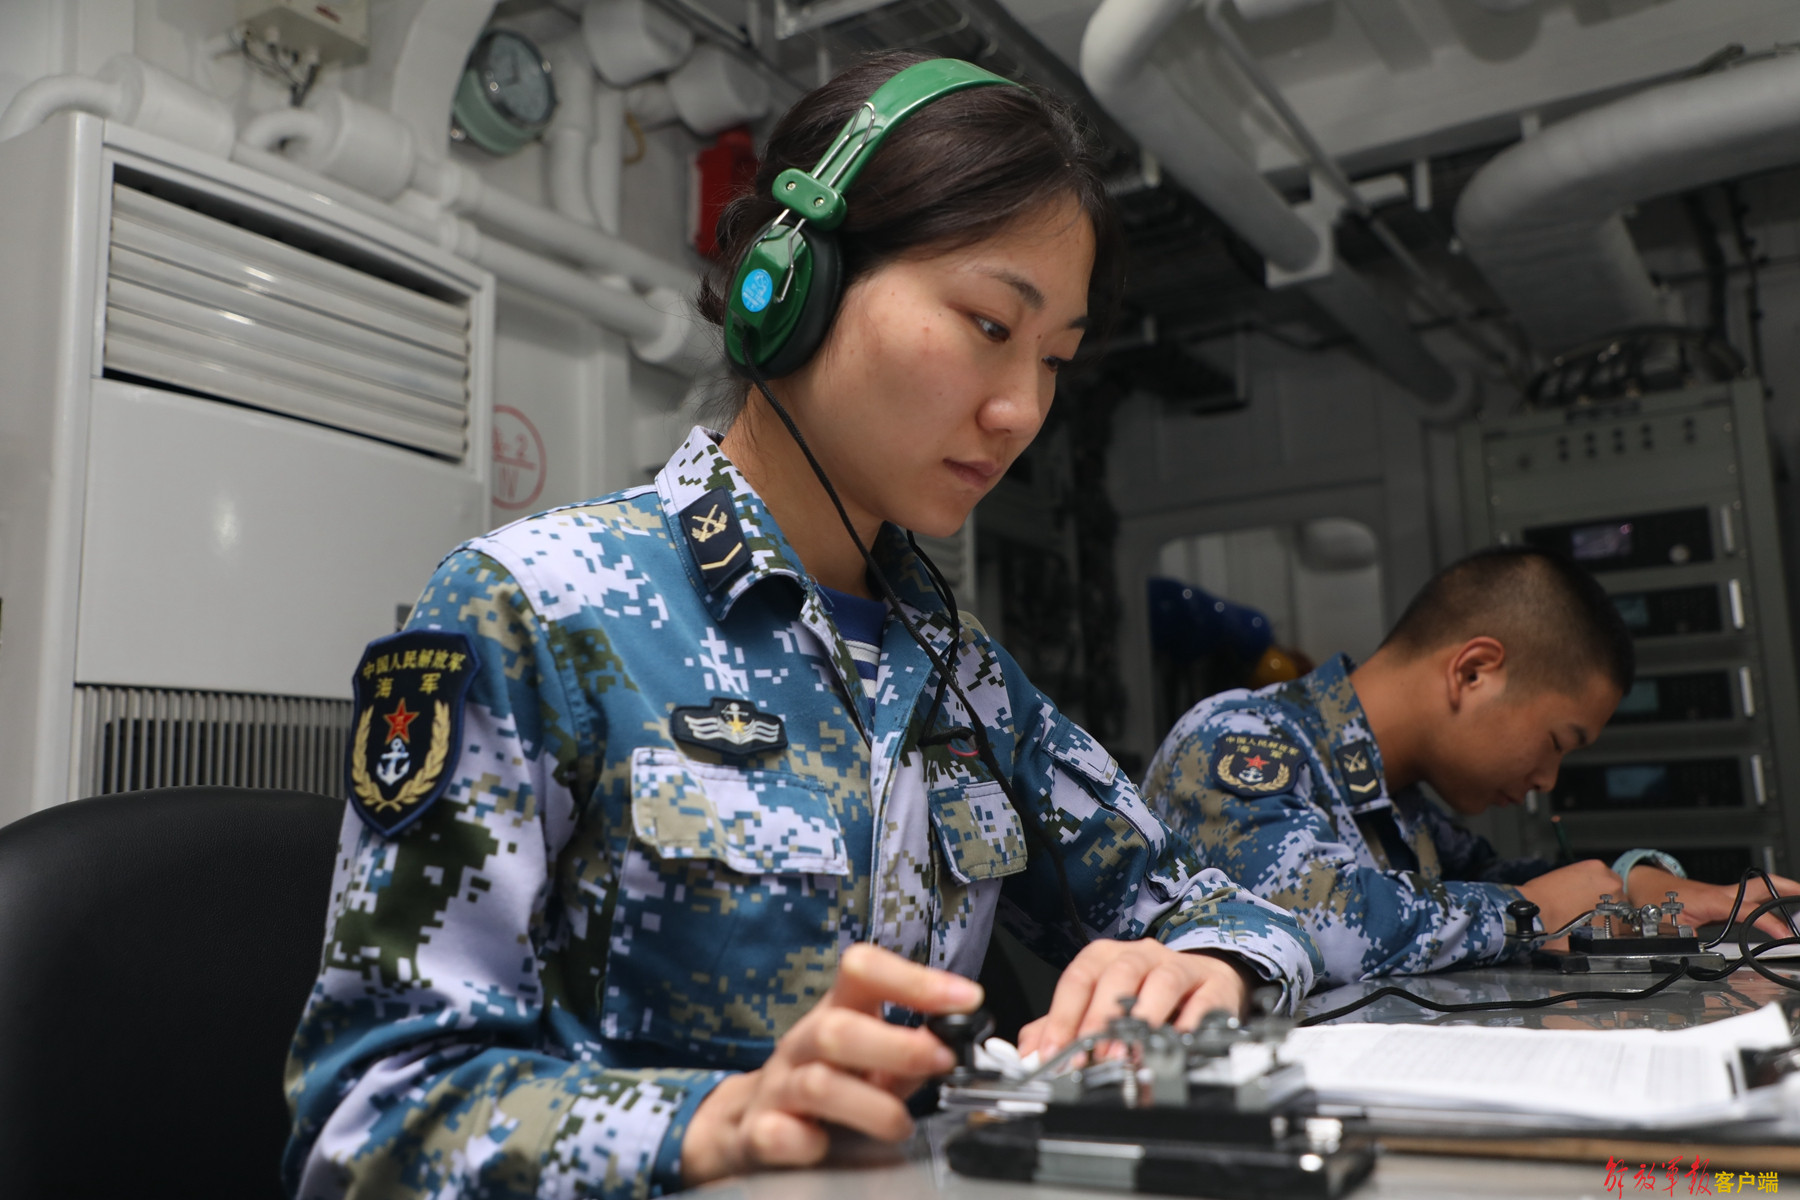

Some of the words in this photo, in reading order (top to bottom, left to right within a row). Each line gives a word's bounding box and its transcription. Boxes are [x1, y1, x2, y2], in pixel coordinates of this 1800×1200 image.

[363, 649, 466, 679] 中国人民解放军
